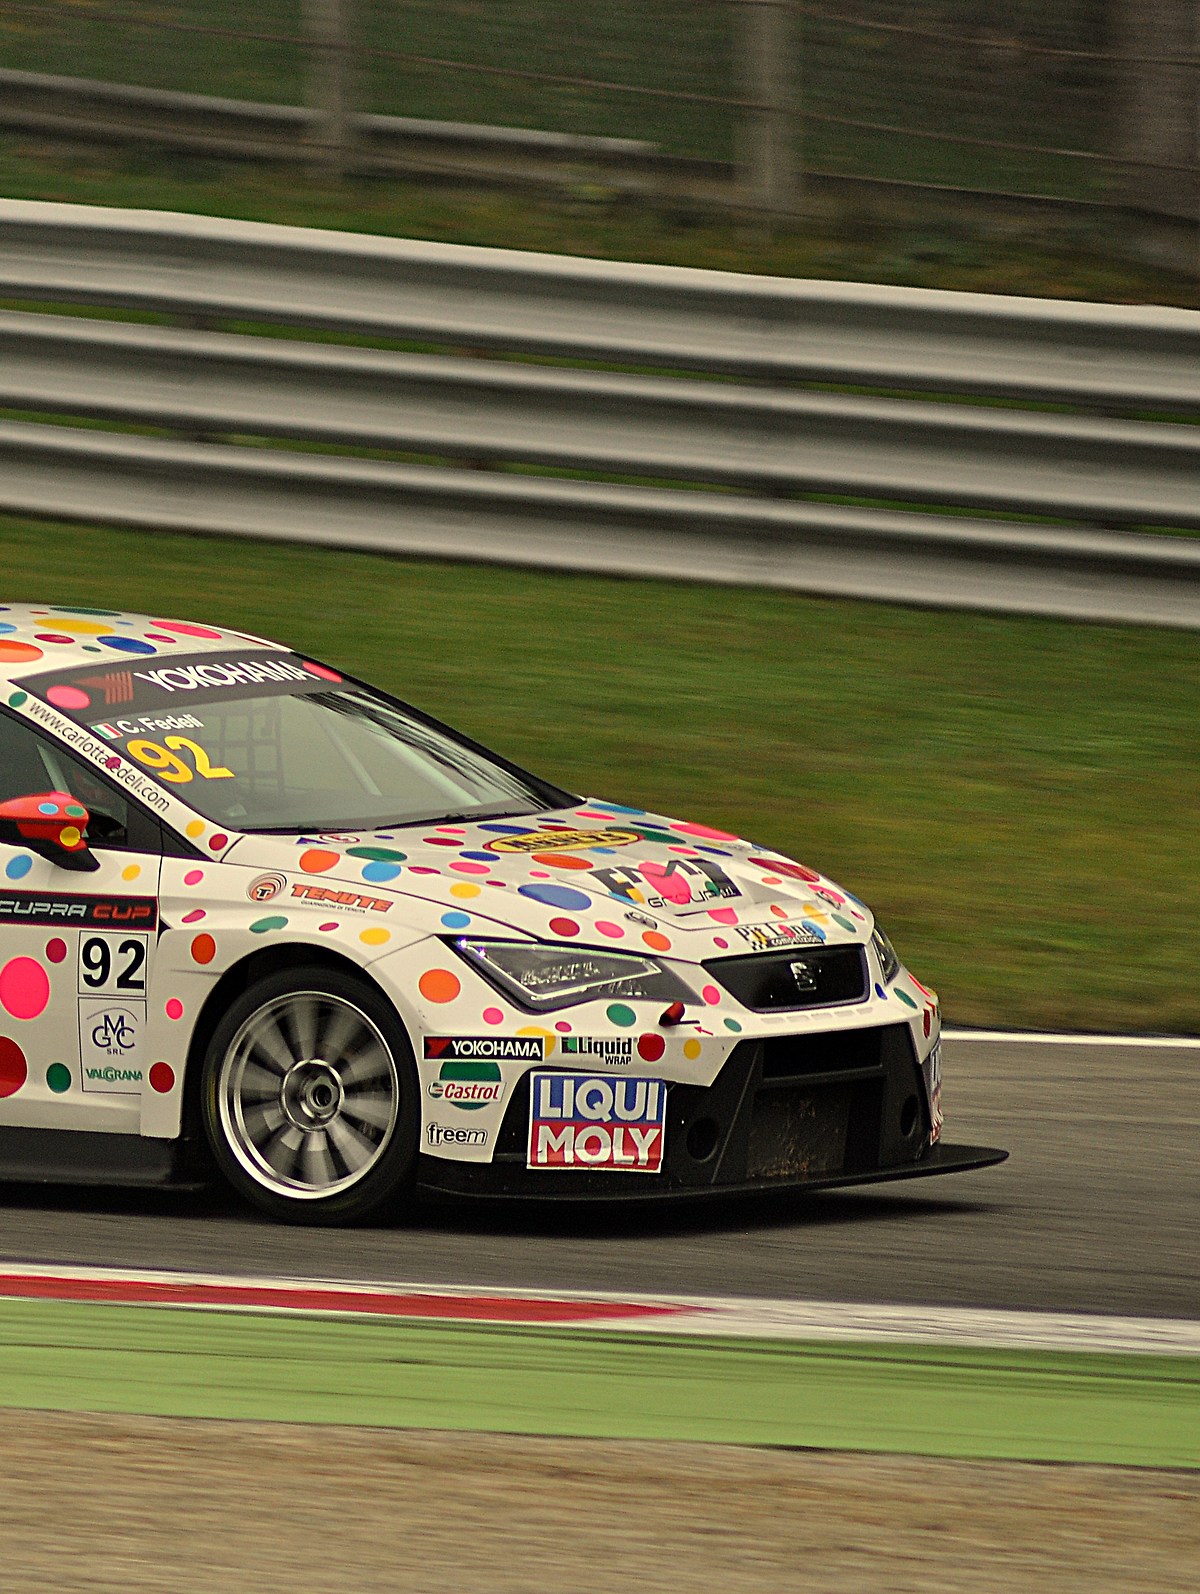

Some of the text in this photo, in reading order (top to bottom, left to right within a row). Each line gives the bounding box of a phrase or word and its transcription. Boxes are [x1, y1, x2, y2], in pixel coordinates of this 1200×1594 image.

[133, 660, 321, 692] YOKOHAMA
[29, 702, 170, 812] www.carlottaedeli.com
[126, 735, 235, 784] 92
[291, 884, 394, 912] TENUTE
[92, 904, 151, 920] CUP
[81, 937, 146, 990] 92
[452, 1040, 542, 1057] YOKOHAMA
[578, 1037, 632, 1058] Liquid
[605, 1056, 632, 1065] WRAP
[86, 1066, 143, 1082] VALGRANA
[444, 1083, 500, 1100] Castrol
[539, 1079, 660, 1122] LIQUI
[428, 1124, 487, 1143] freem
[537, 1125, 661, 1167] MOLY
